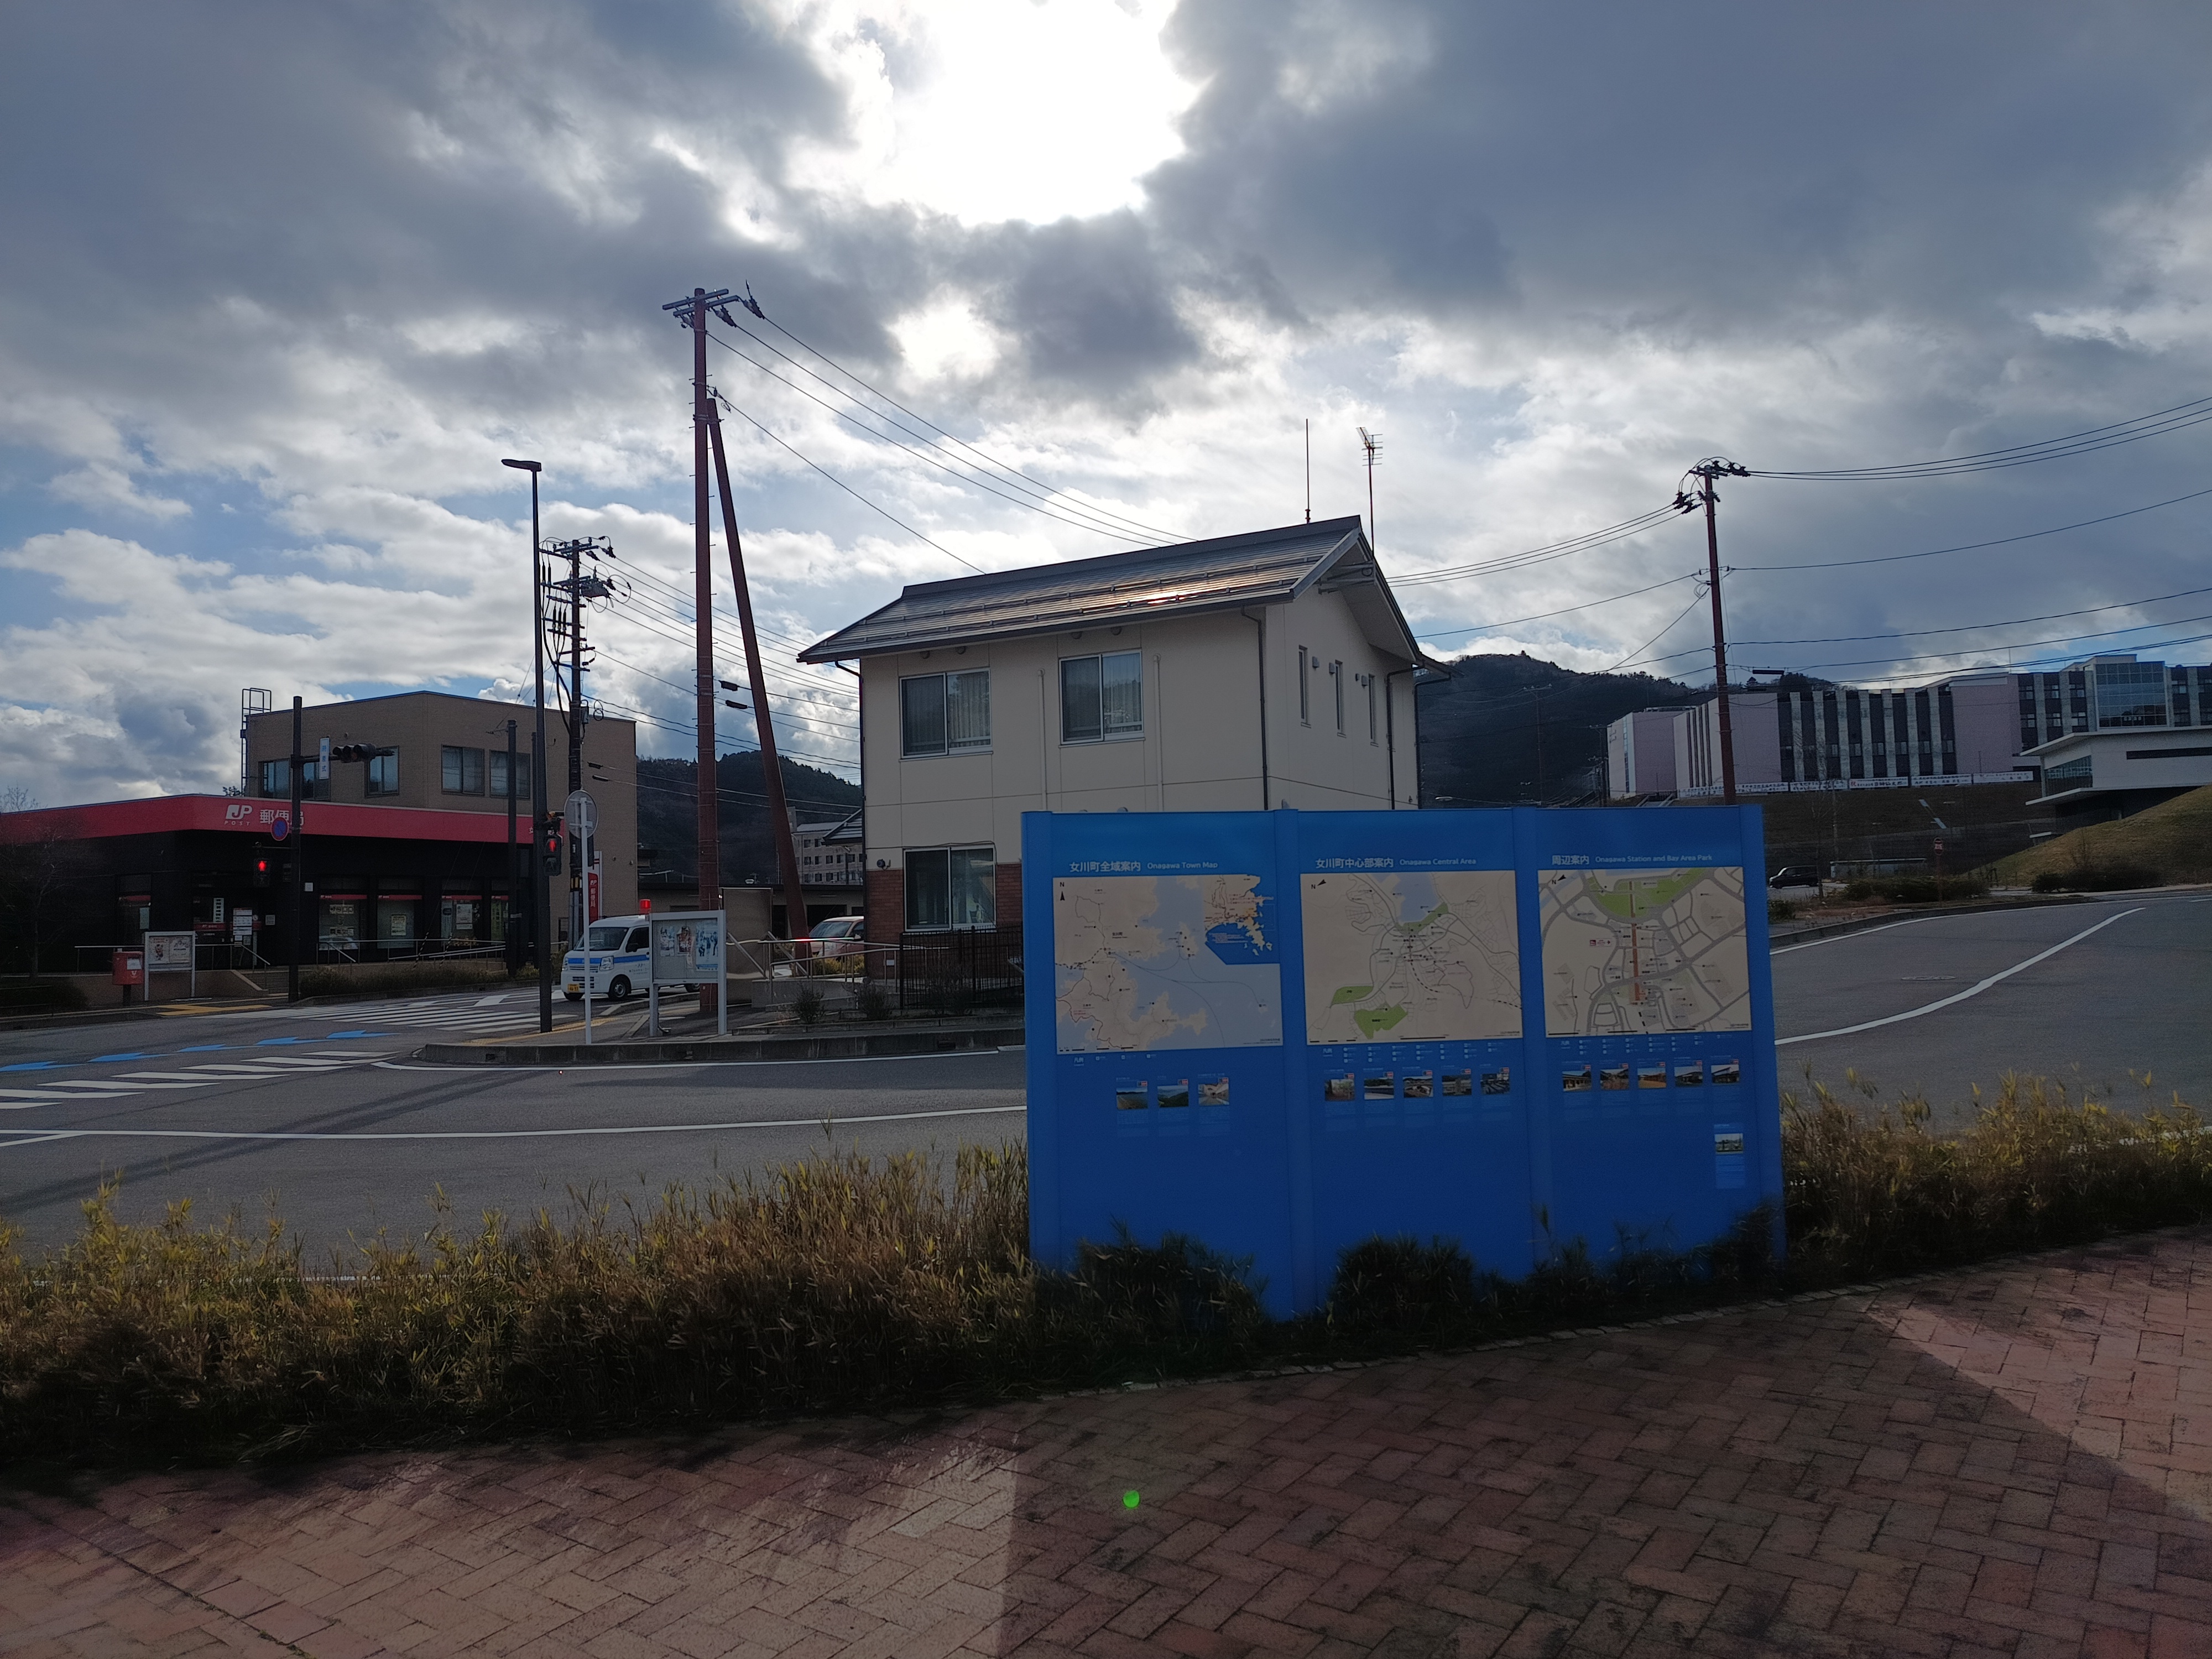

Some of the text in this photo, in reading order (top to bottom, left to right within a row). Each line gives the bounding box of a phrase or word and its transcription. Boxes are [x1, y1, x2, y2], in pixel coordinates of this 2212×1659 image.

[226, 805, 253, 820] JP
[1316, 858, 1394, 869] 女川町中心部案内
[1552, 855, 1590, 865] 周辺案内
[1069, 861, 1141, 873] 女川町全域案内
